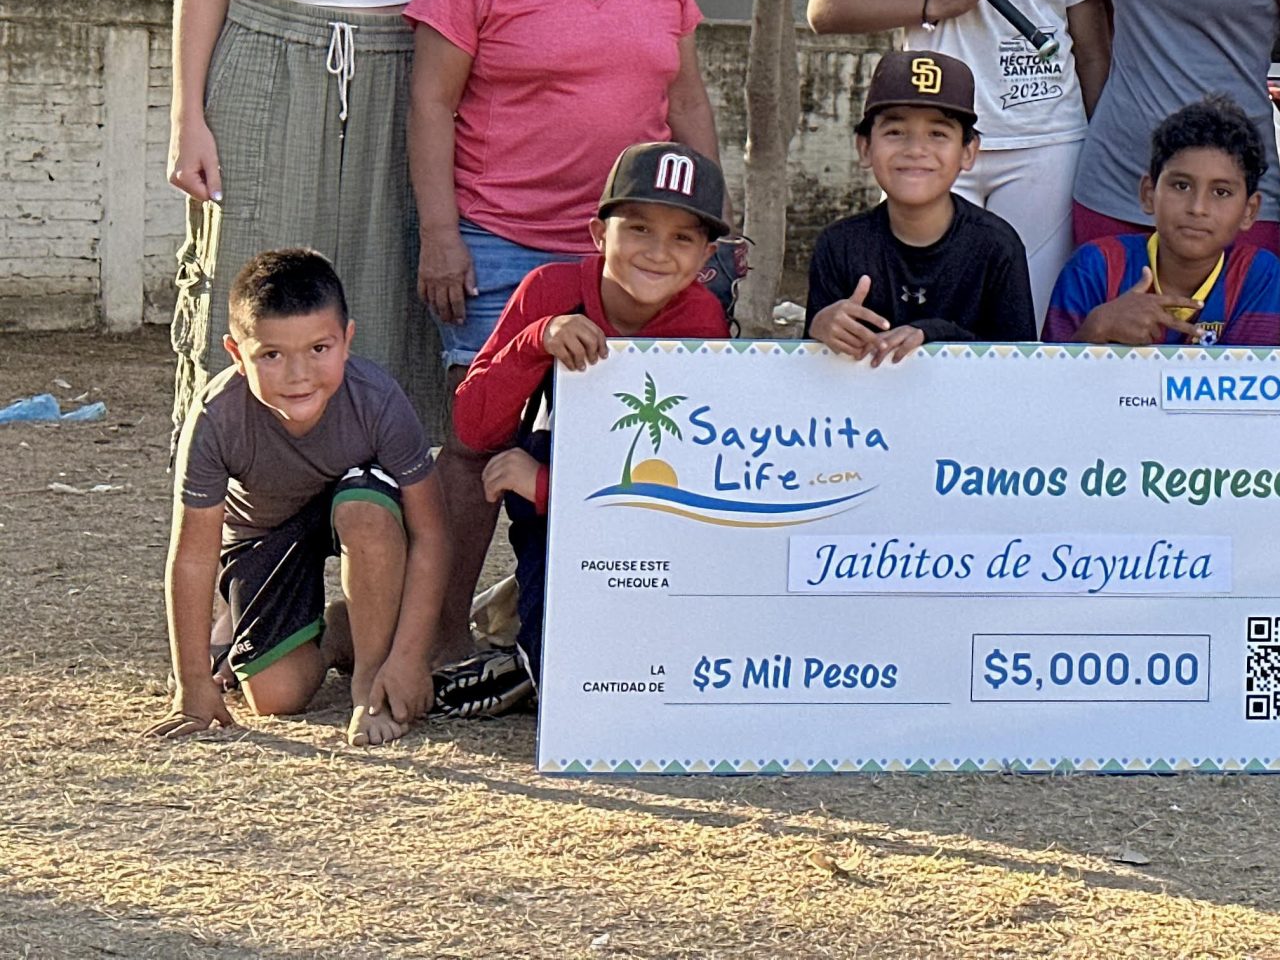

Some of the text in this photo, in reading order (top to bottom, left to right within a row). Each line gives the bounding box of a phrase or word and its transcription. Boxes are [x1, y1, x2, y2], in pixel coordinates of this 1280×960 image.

[911, 57, 942, 94] SD
[1003, 63, 1062, 77] SANTANA
[1010, 81, 1049, 100] 2023
[1119, 396, 1158, 407] FECHA
[689, 405, 889, 458] Sayulita
[935, 459, 1068, 497] Damos
[1080, 458, 1128, 497] de
[581, 560, 670, 571] PAGUESE ESTE
[807, 538, 1212, 594] Jaibitos de Sayulita
[608, 577, 669, 588] CHEQUE A
[650, 665, 665, 676] LA
[692, 654, 898, 692] $5 Mil Pesos
[984, 648, 1199, 691] $5,000.00
[583, 682, 665, 693] CANTIDAD DE
